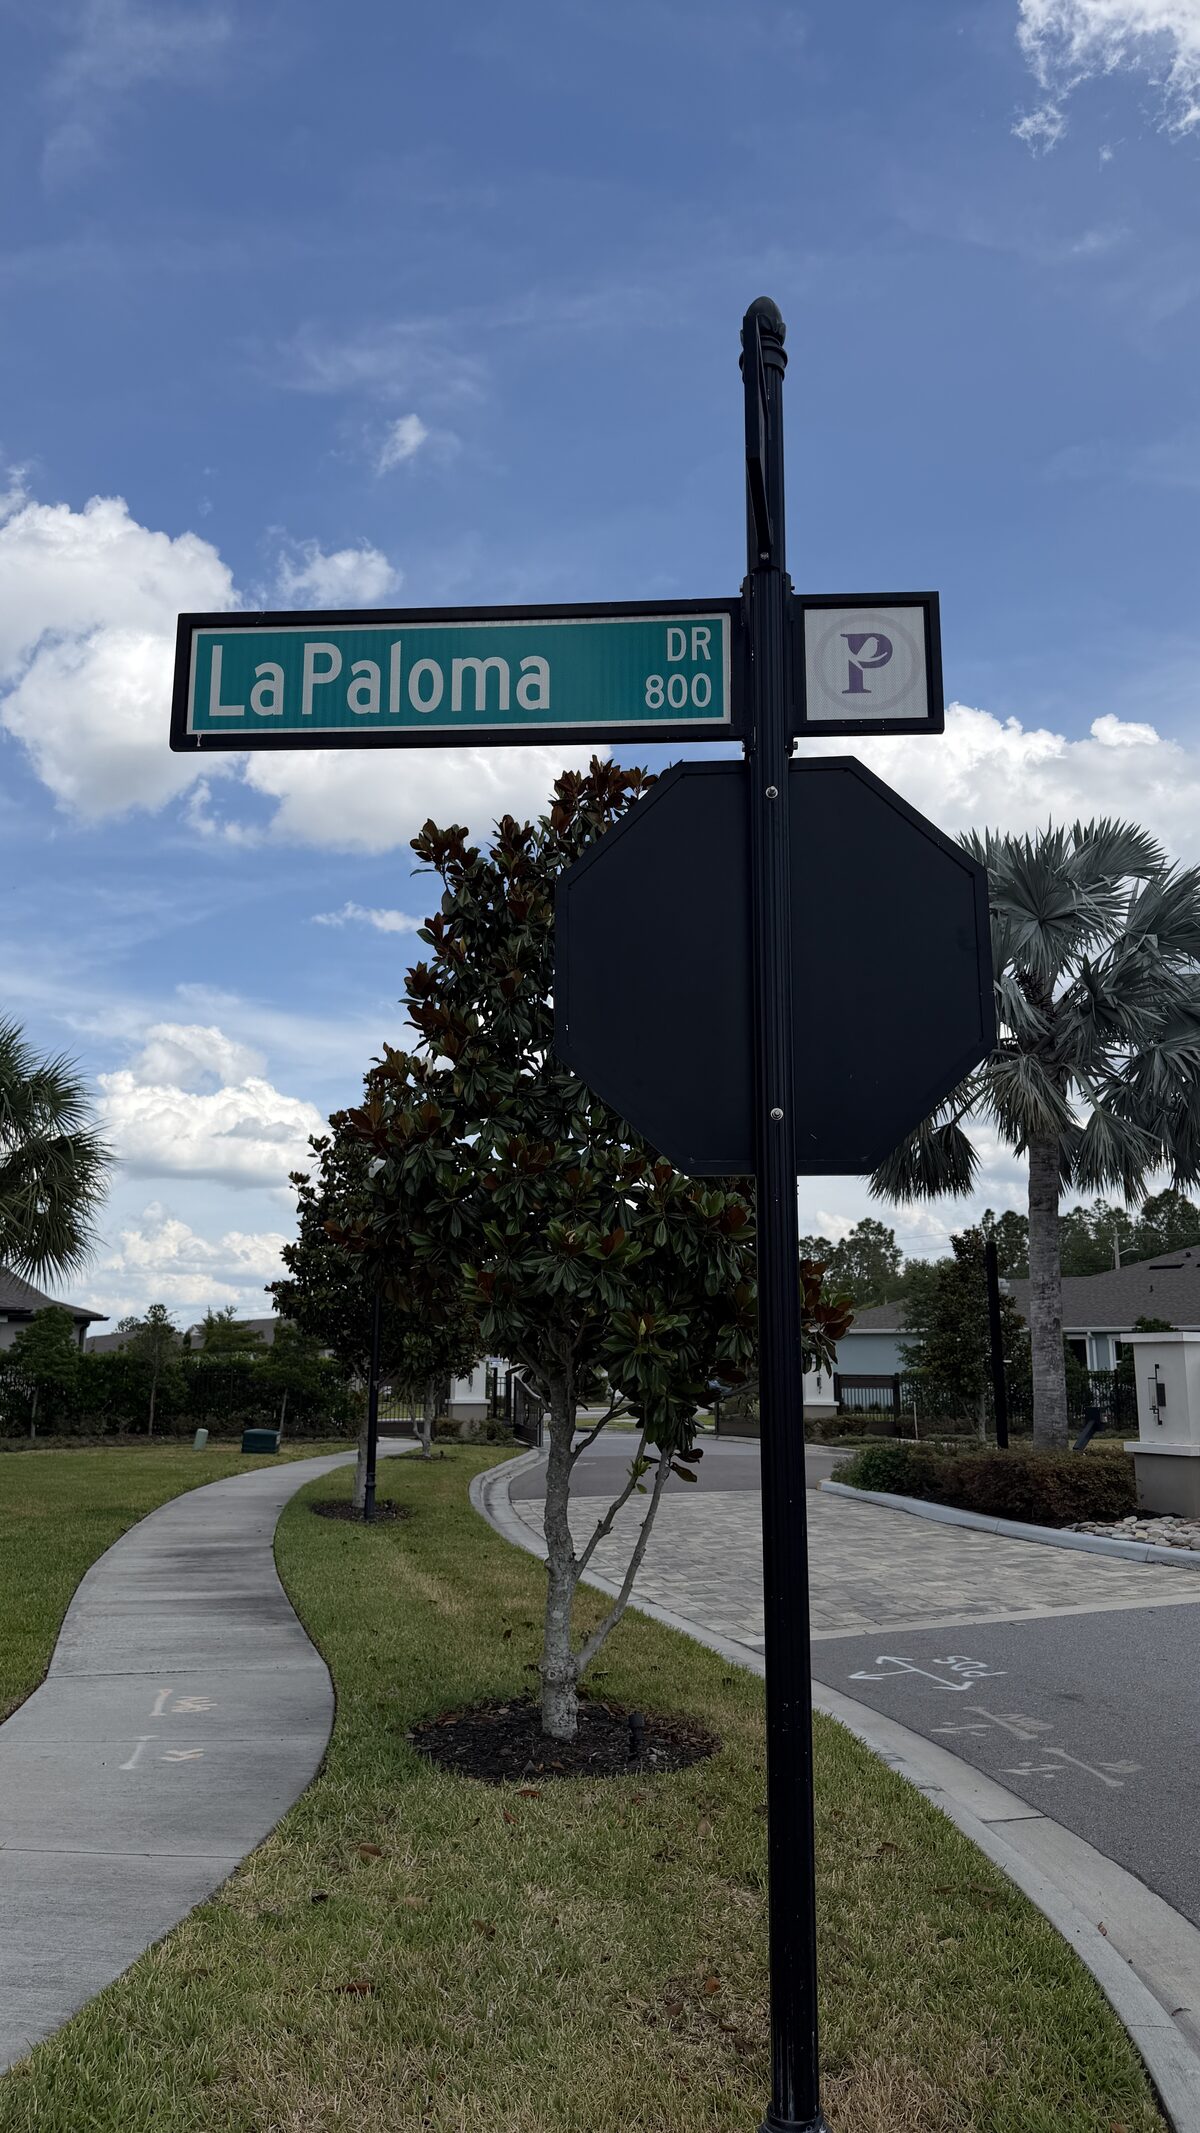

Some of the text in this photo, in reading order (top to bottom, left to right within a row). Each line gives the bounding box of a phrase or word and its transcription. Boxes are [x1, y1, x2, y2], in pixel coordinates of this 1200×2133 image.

[667, 626, 711, 661] DR
[840, 633, 893, 694] P
[645, 673, 712, 709] 800
